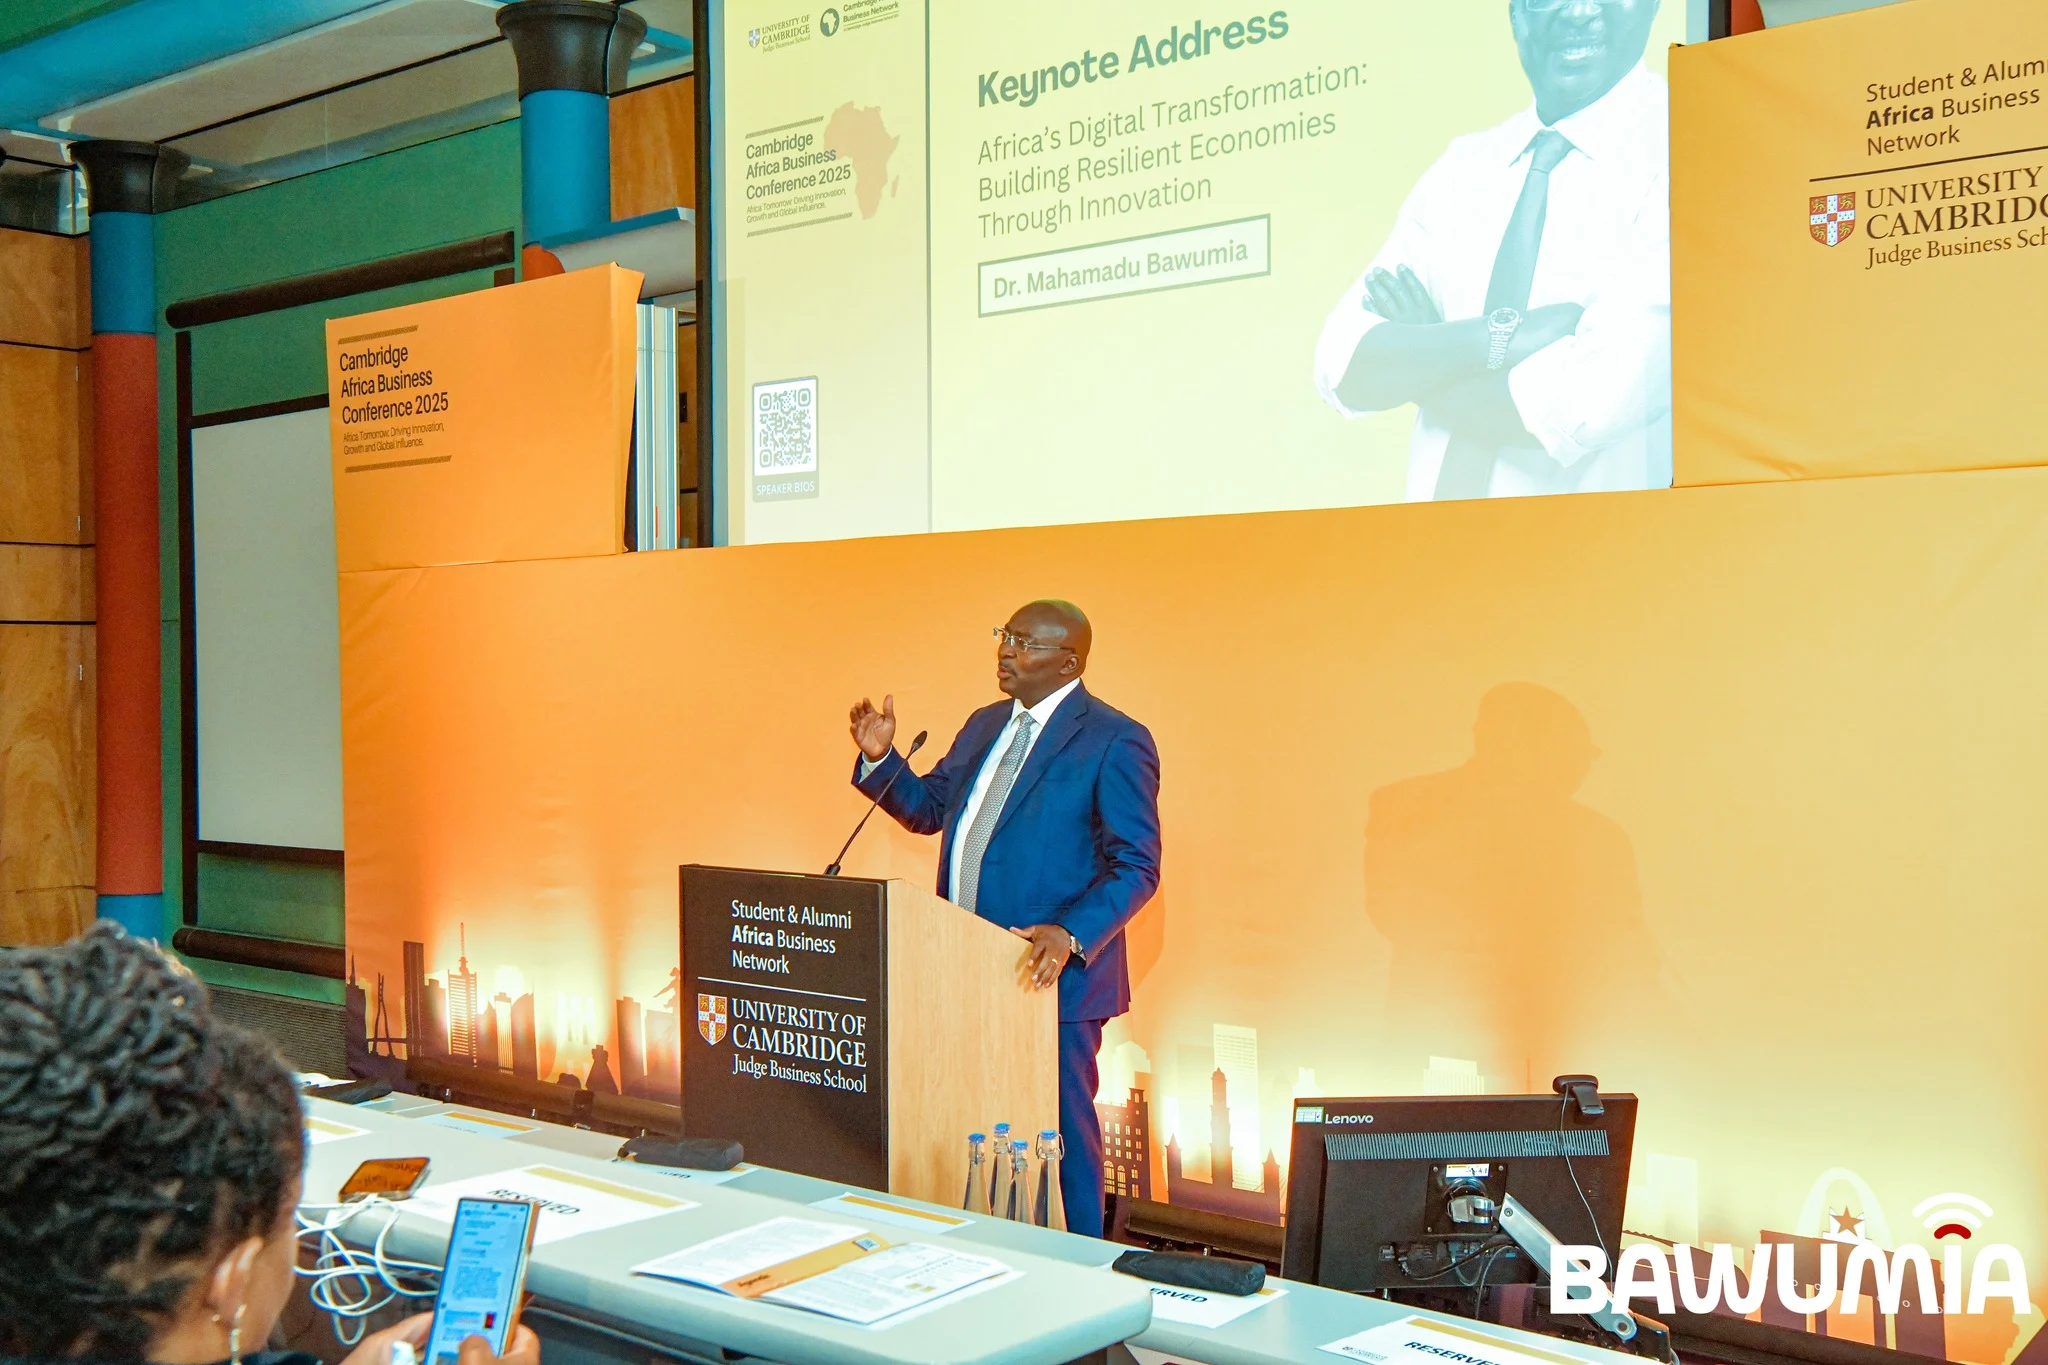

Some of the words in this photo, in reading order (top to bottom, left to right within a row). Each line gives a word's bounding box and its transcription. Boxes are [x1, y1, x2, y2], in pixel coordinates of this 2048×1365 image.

[762, 17, 800, 34] UNIVERSITY
[801, 14, 810, 23] OF
[843, 11, 870, 23] Business
[870, 1, 898, 15] Network
[762, 24, 810, 45] CAMBRIDGE
[978, 49, 1120, 108] Keynote
[1127, 10, 1290, 73] Address
[1866, 72, 1954, 103] Student
[1960, 67, 1977, 87] &
[1983, 60, 2048, 84] Alum
[978, 126, 1062, 165] Africa’s
[1069, 105, 1146, 148] Digital
[1152, 63, 1368, 127] Transformation:
[1866, 105, 1934, 129] Africa
[1942, 88, 2040, 118] Business
[746, 133, 813, 159] Cambridge
[1867, 124, 1960, 156] Network
[746, 161, 780, 180] Africa
[782, 149, 837, 172] Business
[979, 163, 1070, 202] Building
[1078, 140, 1182, 182] Resilient
[1190, 111, 1337, 161] Economies
[746, 179, 817, 200] Conference
[818, 164, 852, 185] 2025
[1866, 165, 2043, 208] UNIVERSITY
[978, 199, 1072, 239] Through
[1080, 176, 1212, 222] Innovation
[1865, 244, 1922, 270] Judge
[1927, 236, 2012, 259] Business
[2016, 225, 2048, 248] Sch
[993, 275, 1022, 299] Dr.
[1026, 257, 1141, 294] Mahamadu
[1147, 240, 1249, 275] Bawumia
[340, 344, 408, 371] Cambridge
[341, 377, 375, 398] Africa
[377, 370, 433, 393] Business
[342, 401, 412, 424] Conference
[415, 391, 449, 415] 2025
[756, 482, 792, 496] SPEAKER
[794, 481, 815, 493] BIOS
[731, 899, 784, 923] Student
[787, 904, 798, 924] &
[801, 906, 852, 930] Alumni
[732, 925, 773, 947] Africa
[777, 930, 836, 954] Business
[732, 949, 790, 974] Network
[732, 998, 839, 1033] UNIVERSITY
[841, 1014, 867, 1037] OF
[732, 1023, 867, 1068] CAMBRIDGE
[732, 1053, 768, 1079] Judge
[769, 1059, 821, 1086] Business
[823, 1068, 867, 1093] School
[1325, 1114, 1374, 1125] Lenovo
[1151, 1287, 1208, 1302] ERVED
[1404, 1341, 1503, 1365] RESERVE
